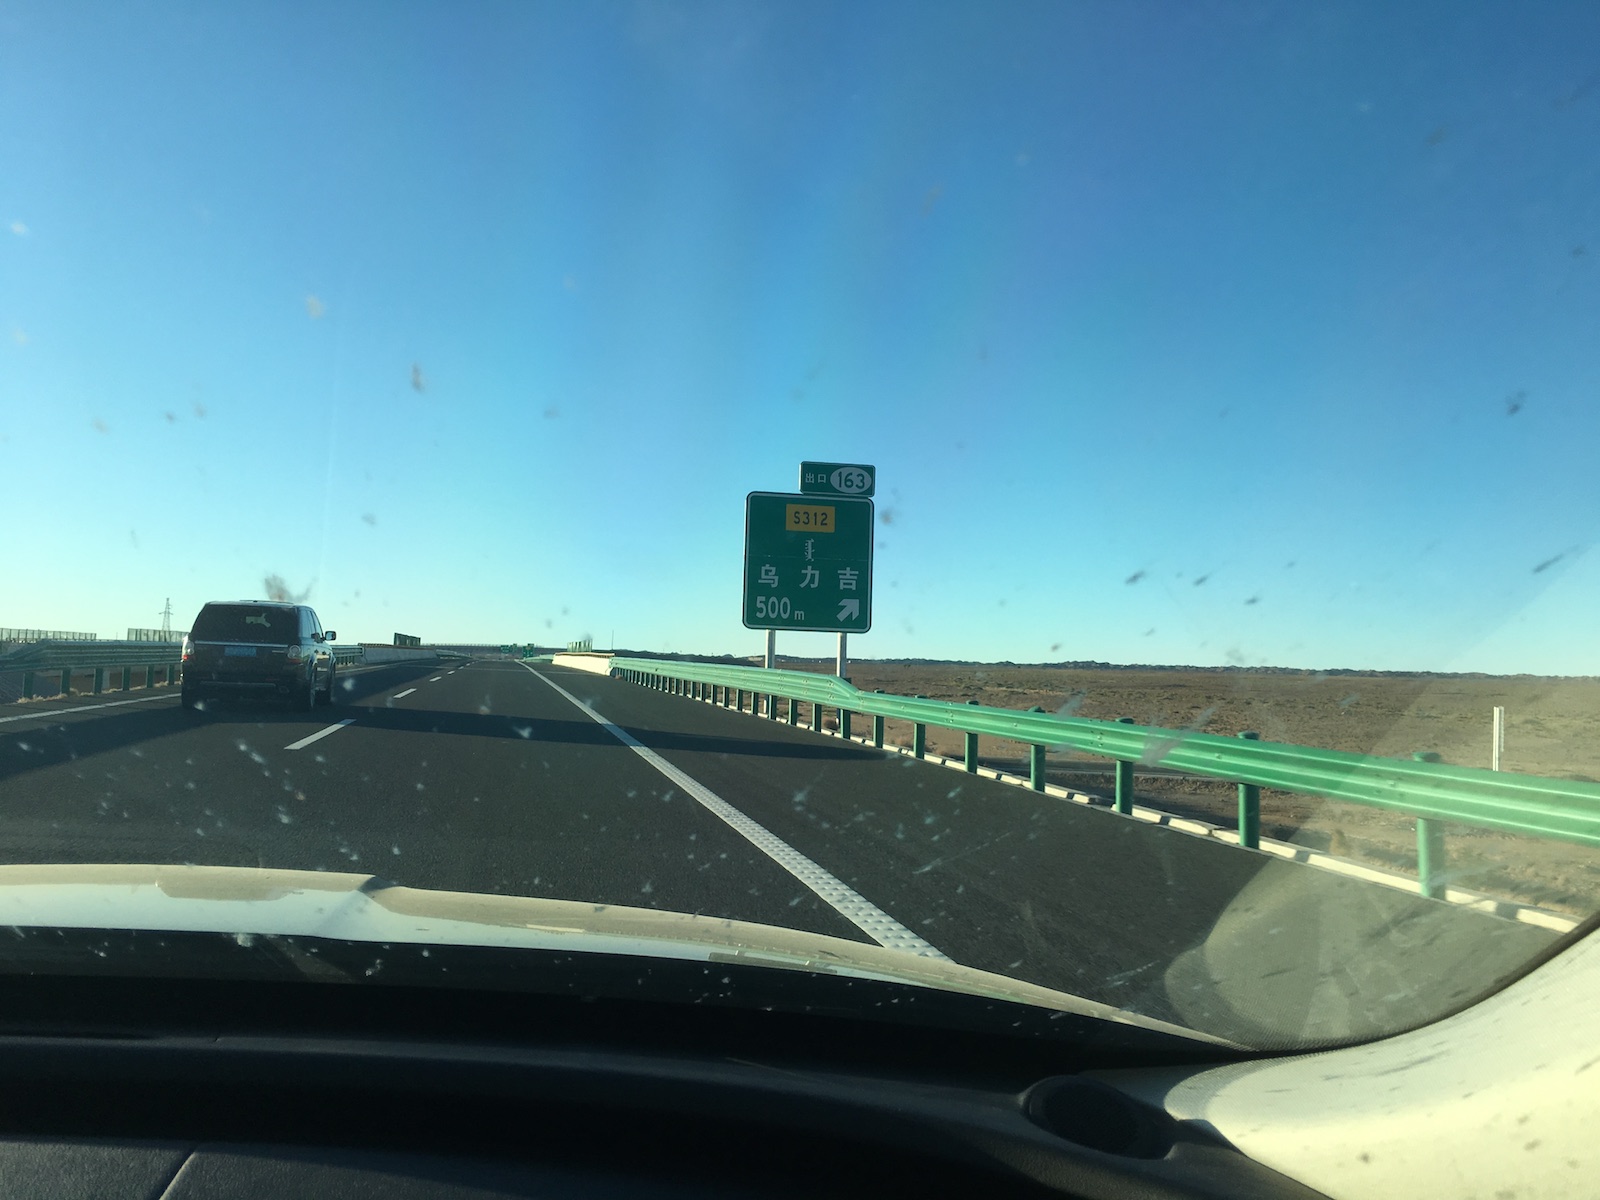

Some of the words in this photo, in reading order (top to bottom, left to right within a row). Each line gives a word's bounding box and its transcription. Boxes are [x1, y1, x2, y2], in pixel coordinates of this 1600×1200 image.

[805, 472, 826, 484] 出口
[838, 471, 865, 490] 163
[793, 511, 828, 526] S312
[758, 564, 859, 590] 乌力吉
